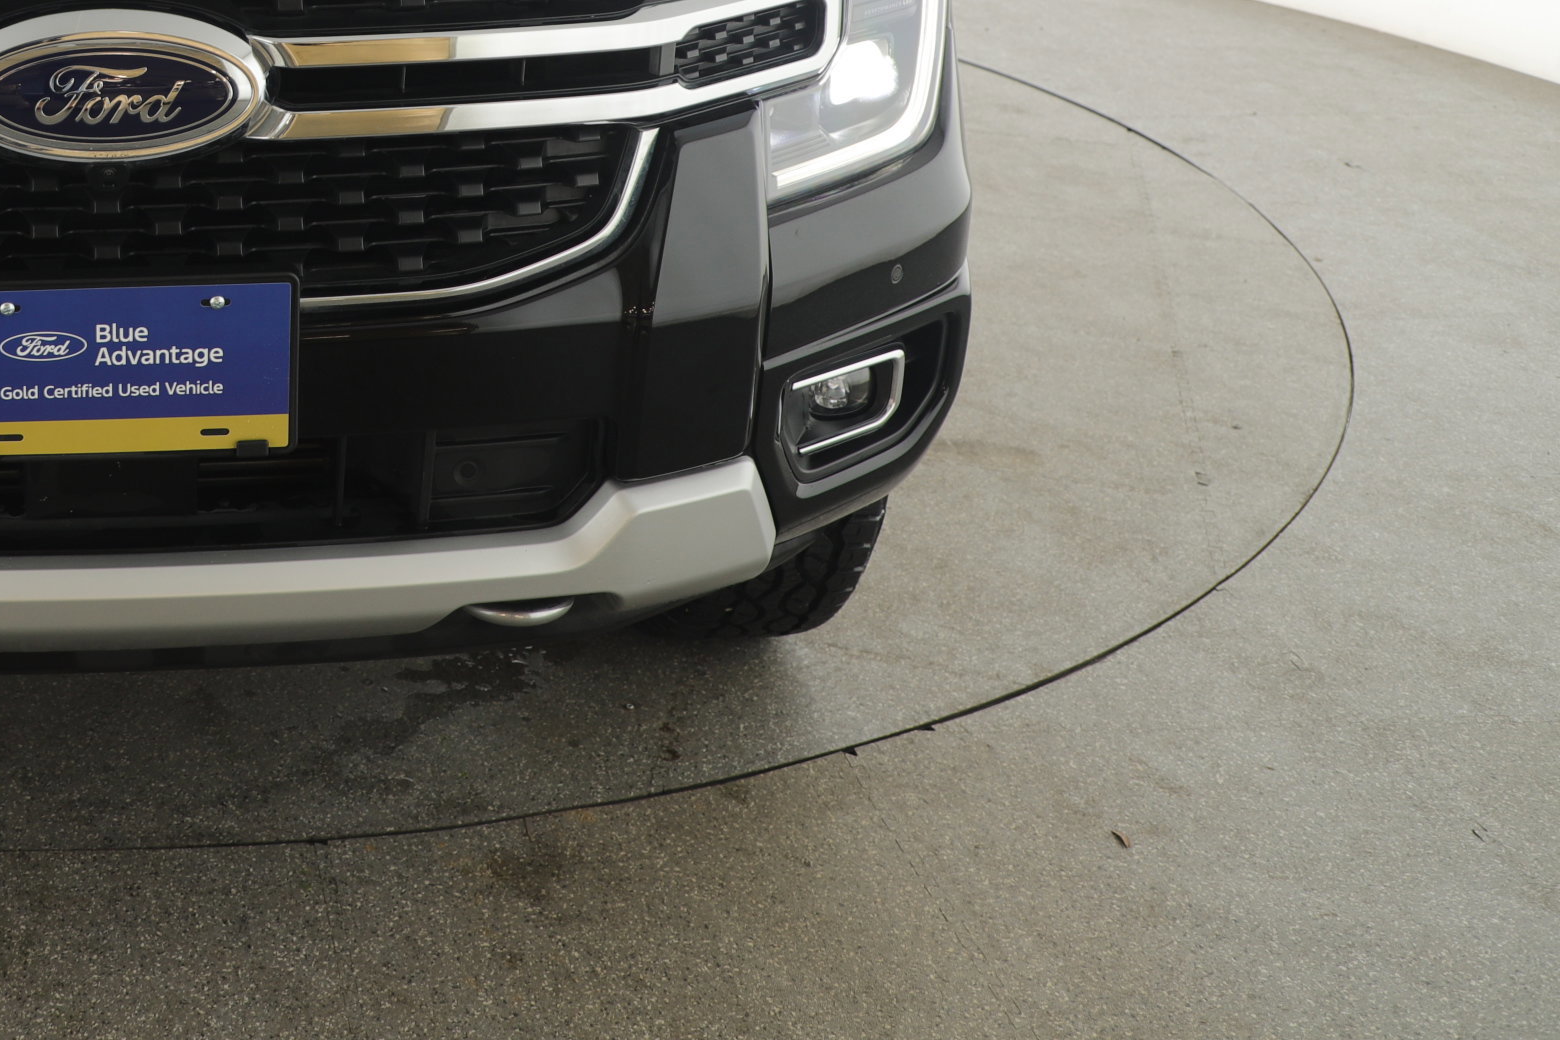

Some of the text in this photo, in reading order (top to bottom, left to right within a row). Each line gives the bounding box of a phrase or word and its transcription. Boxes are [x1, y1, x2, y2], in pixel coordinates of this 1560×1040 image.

[35, 65, 186, 126] Ford
[95, 323, 148, 343] Blue
[16, 335, 70, 357] Ford
[94, 344, 224, 368] Advantage
[0, 379, 224, 401] Gold Certified Used Vehicle
